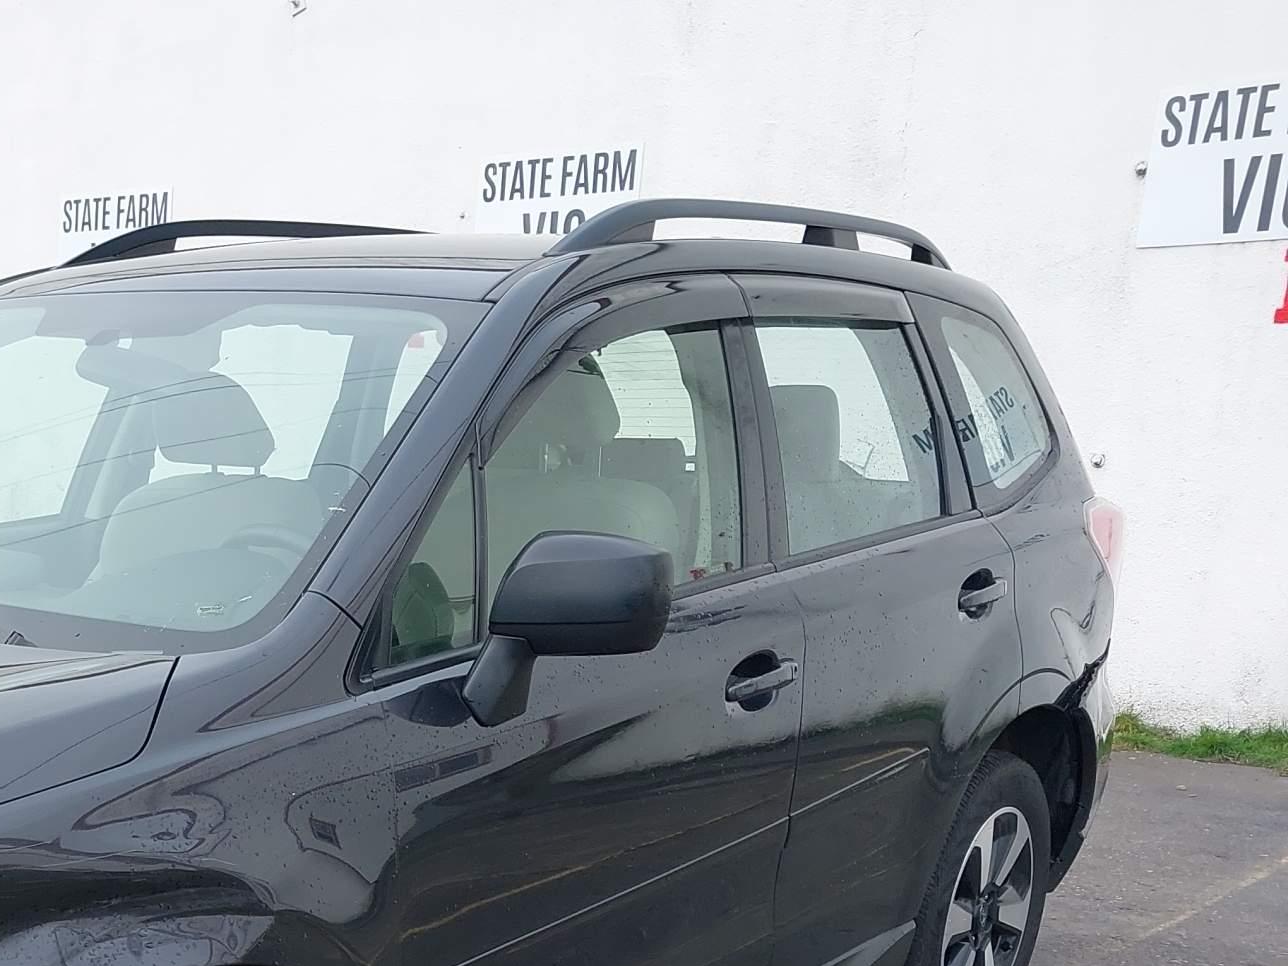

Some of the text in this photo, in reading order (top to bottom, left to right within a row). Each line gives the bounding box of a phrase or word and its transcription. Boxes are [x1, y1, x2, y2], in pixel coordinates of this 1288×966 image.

[1160, 83, 1281, 148] STATE
[482, 149, 638, 203] STATE FARM
[1222, 153, 1288, 234] VI
[62, 191, 169, 234] STATE FARM
